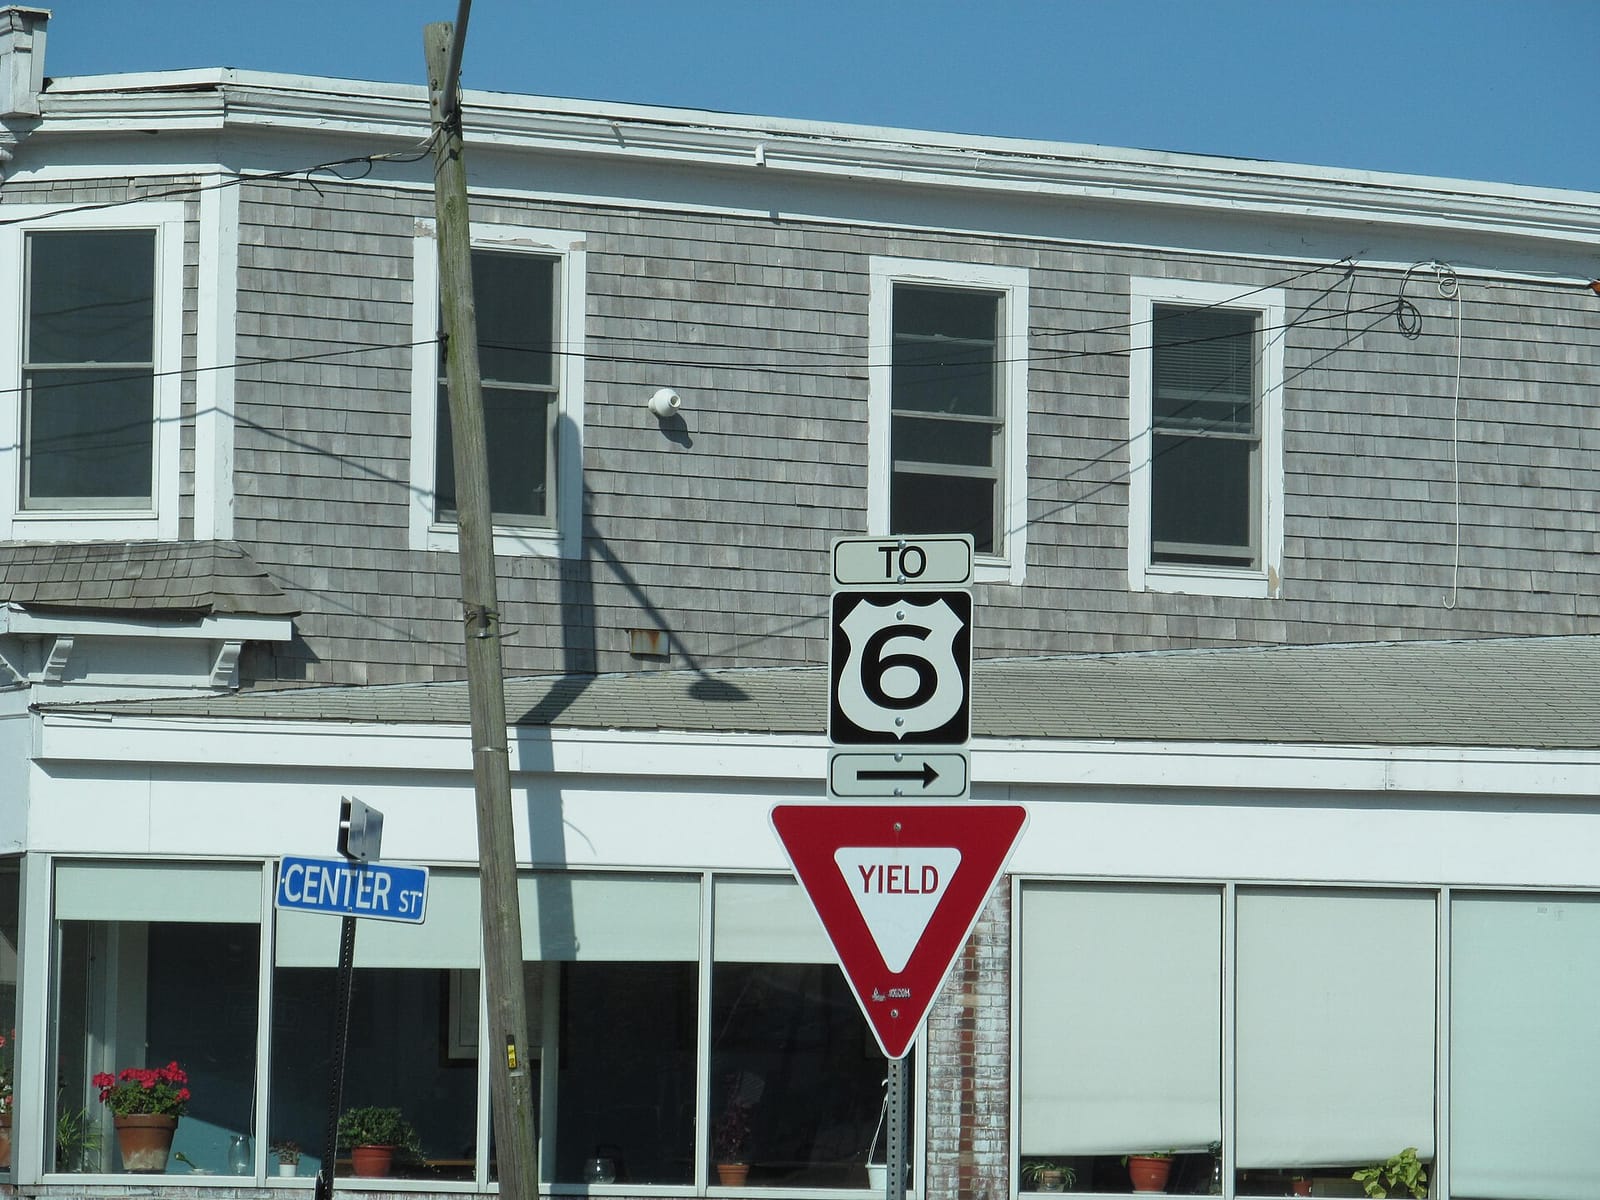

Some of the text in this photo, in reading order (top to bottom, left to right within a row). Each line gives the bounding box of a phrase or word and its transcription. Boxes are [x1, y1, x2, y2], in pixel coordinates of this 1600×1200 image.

[878, 545, 927, 578] TO
[860, 624, 938, 710] 6
[284, 864, 421, 913] CENTER ST
[858, 865, 939, 894] YIELD
